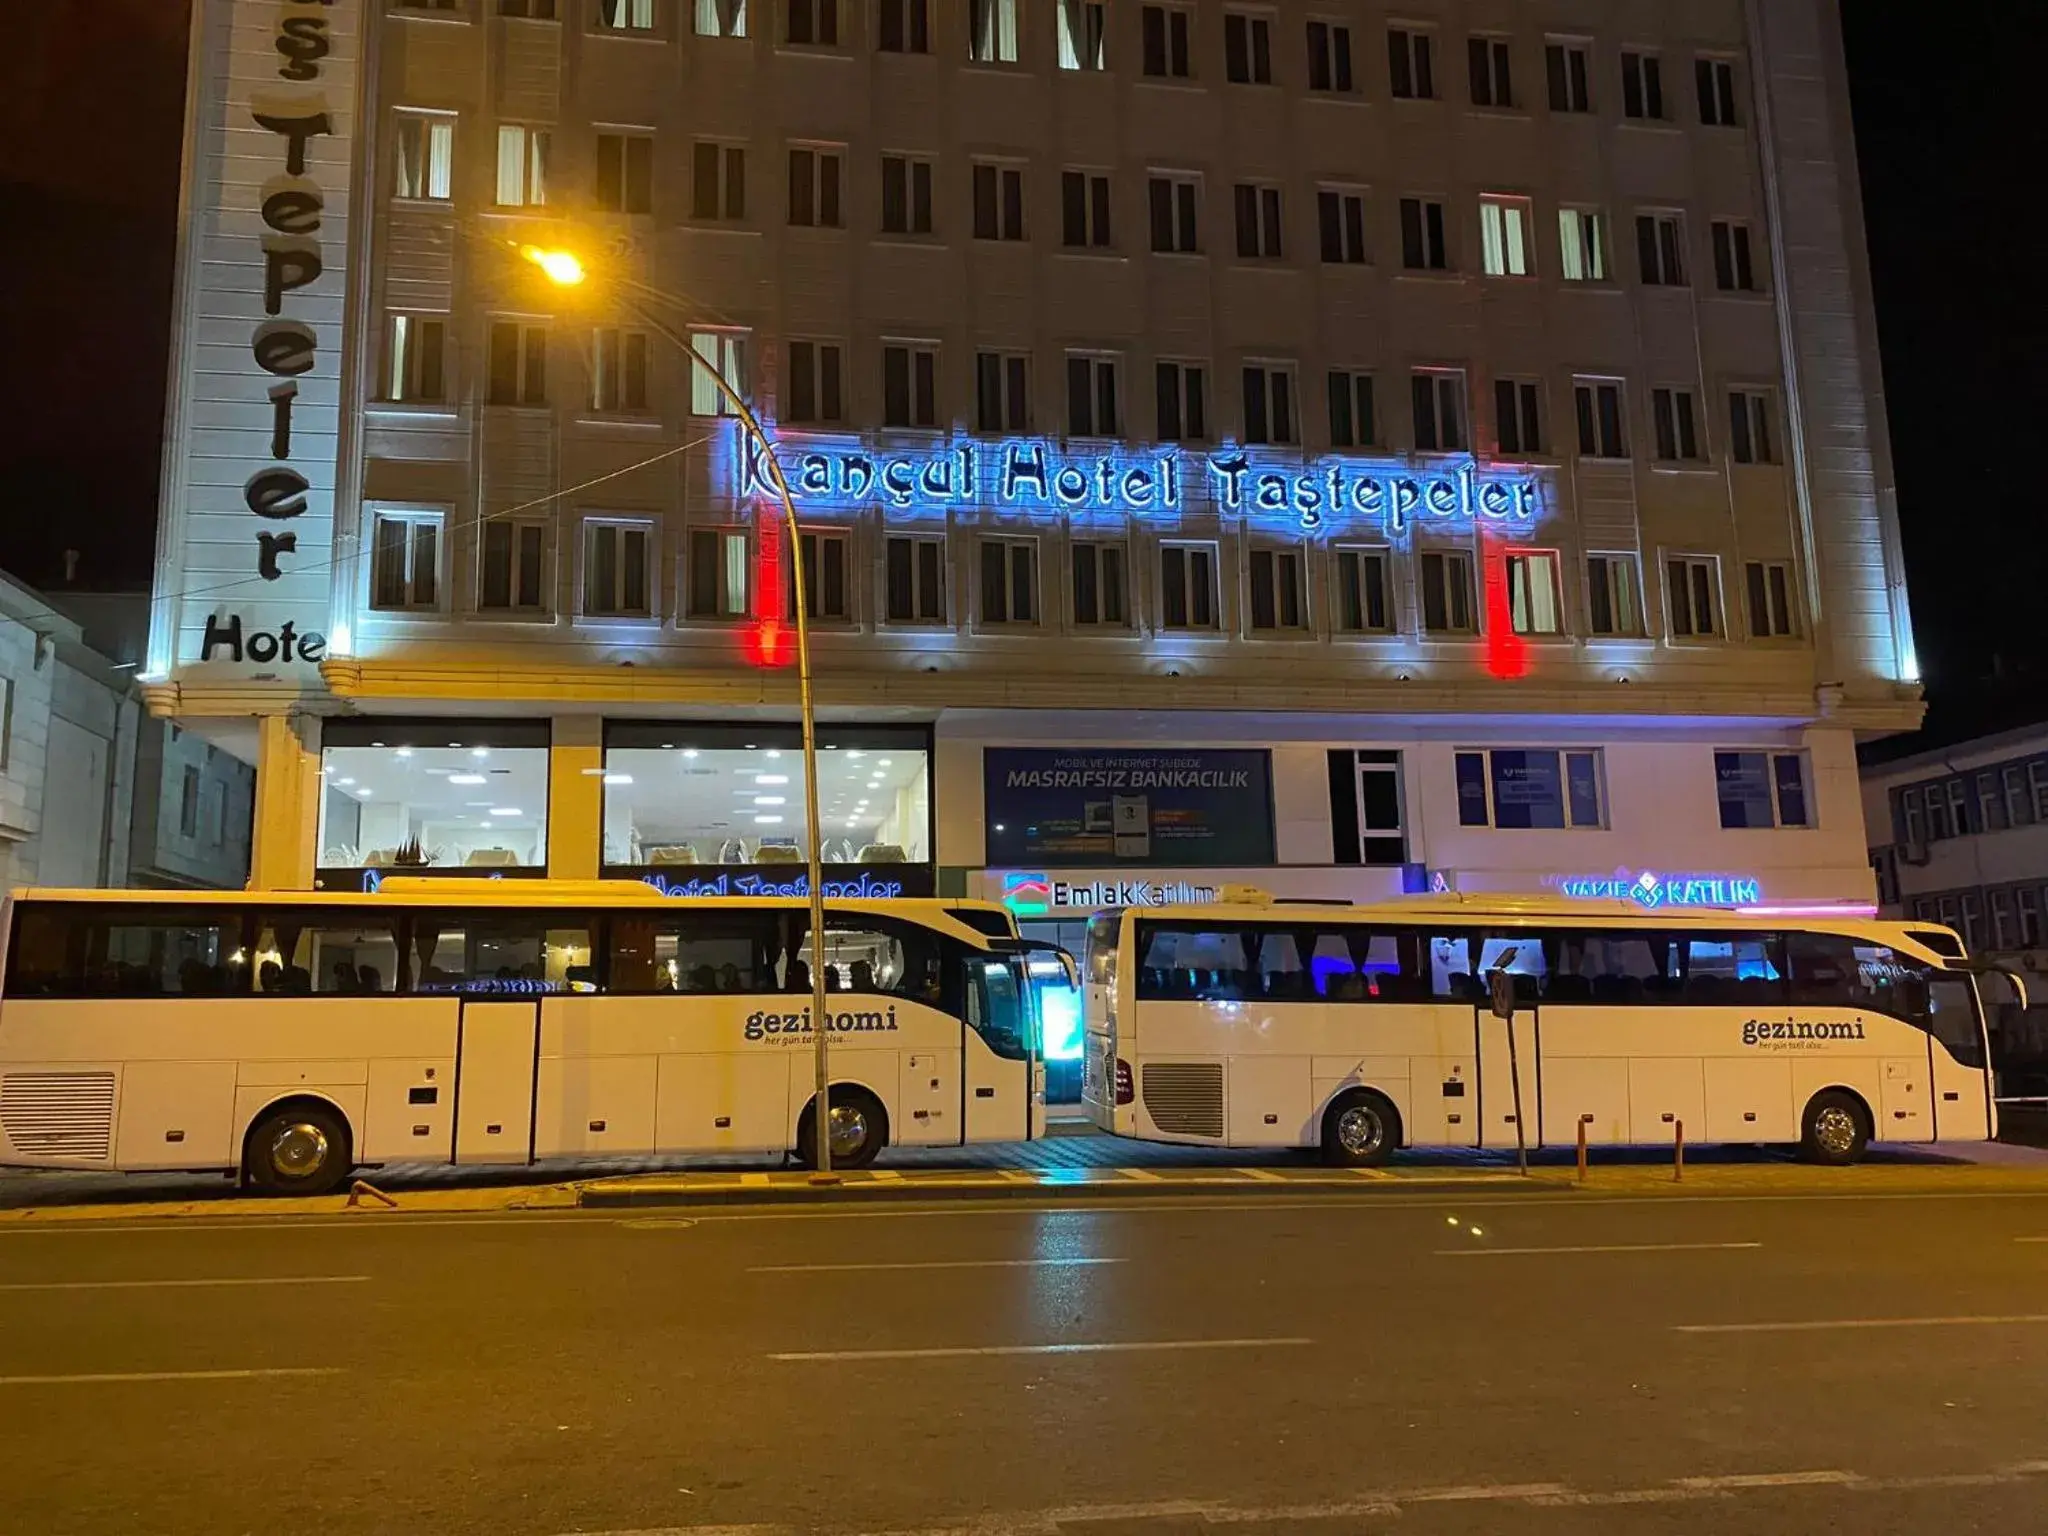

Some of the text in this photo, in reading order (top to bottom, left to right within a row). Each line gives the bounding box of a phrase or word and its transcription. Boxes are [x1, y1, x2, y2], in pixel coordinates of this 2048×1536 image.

[1004, 443, 1178, 506] Hotel
[1207, 453, 1536, 531] Taştepeler
[201, 613, 327, 663] Hote
[1090, 758, 1103, 768] VE
[1007, 770, 1249, 788] MASRAFSIZ BANKACILIK
[1667, 878, 1760, 904] KATILIM
[1742, 1016, 1865, 1045] gezinomi
